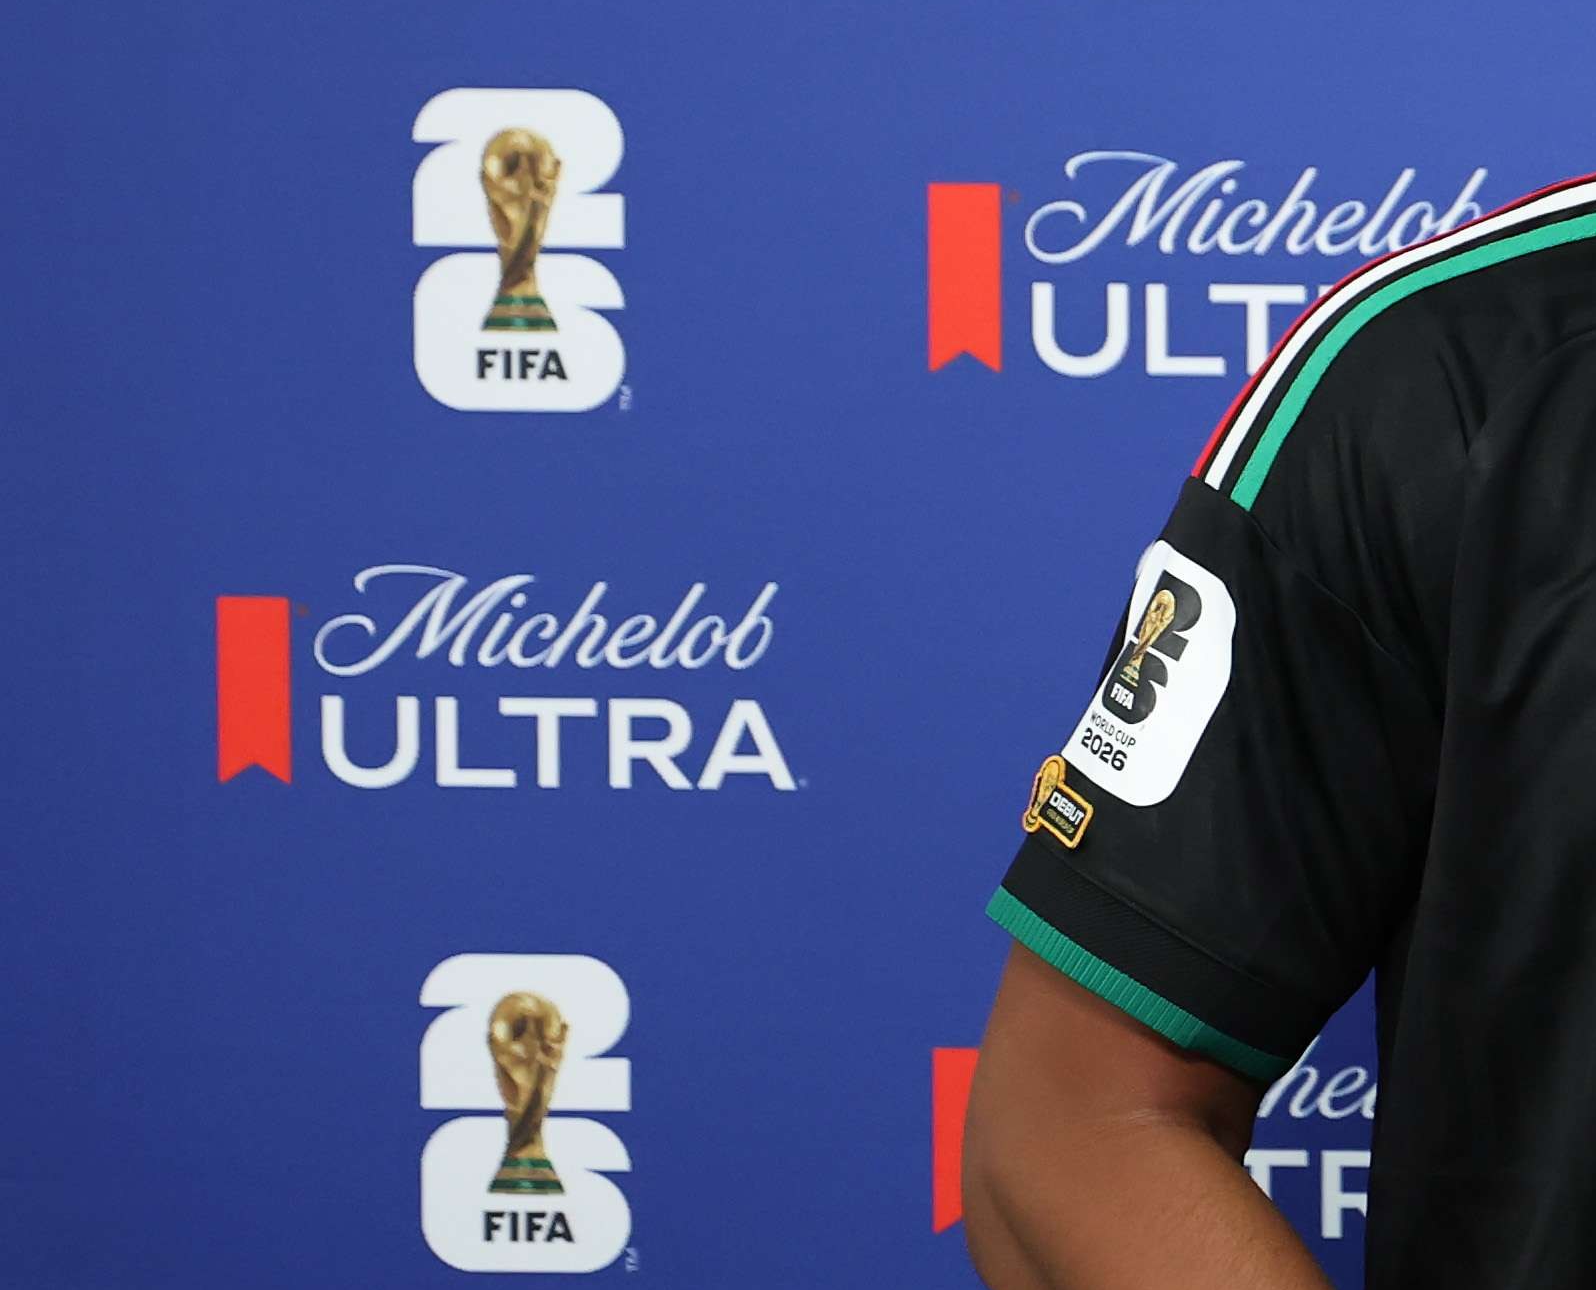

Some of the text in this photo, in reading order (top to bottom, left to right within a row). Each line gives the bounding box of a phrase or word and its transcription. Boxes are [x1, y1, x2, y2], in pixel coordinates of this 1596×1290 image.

[1031, 282, 1338, 378] ULT
[477, 349, 568, 380] FIFA
[314, 565, 778, 675] Michelob
[1110, 682, 1136, 711] FIFA
[322, 695, 796, 790] ULTRA
[1080, 727, 1128, 772] 2026
[1089, 711, 1137, 748] WORLD CUP
[484, 1211, 574, 1243] FIFA
